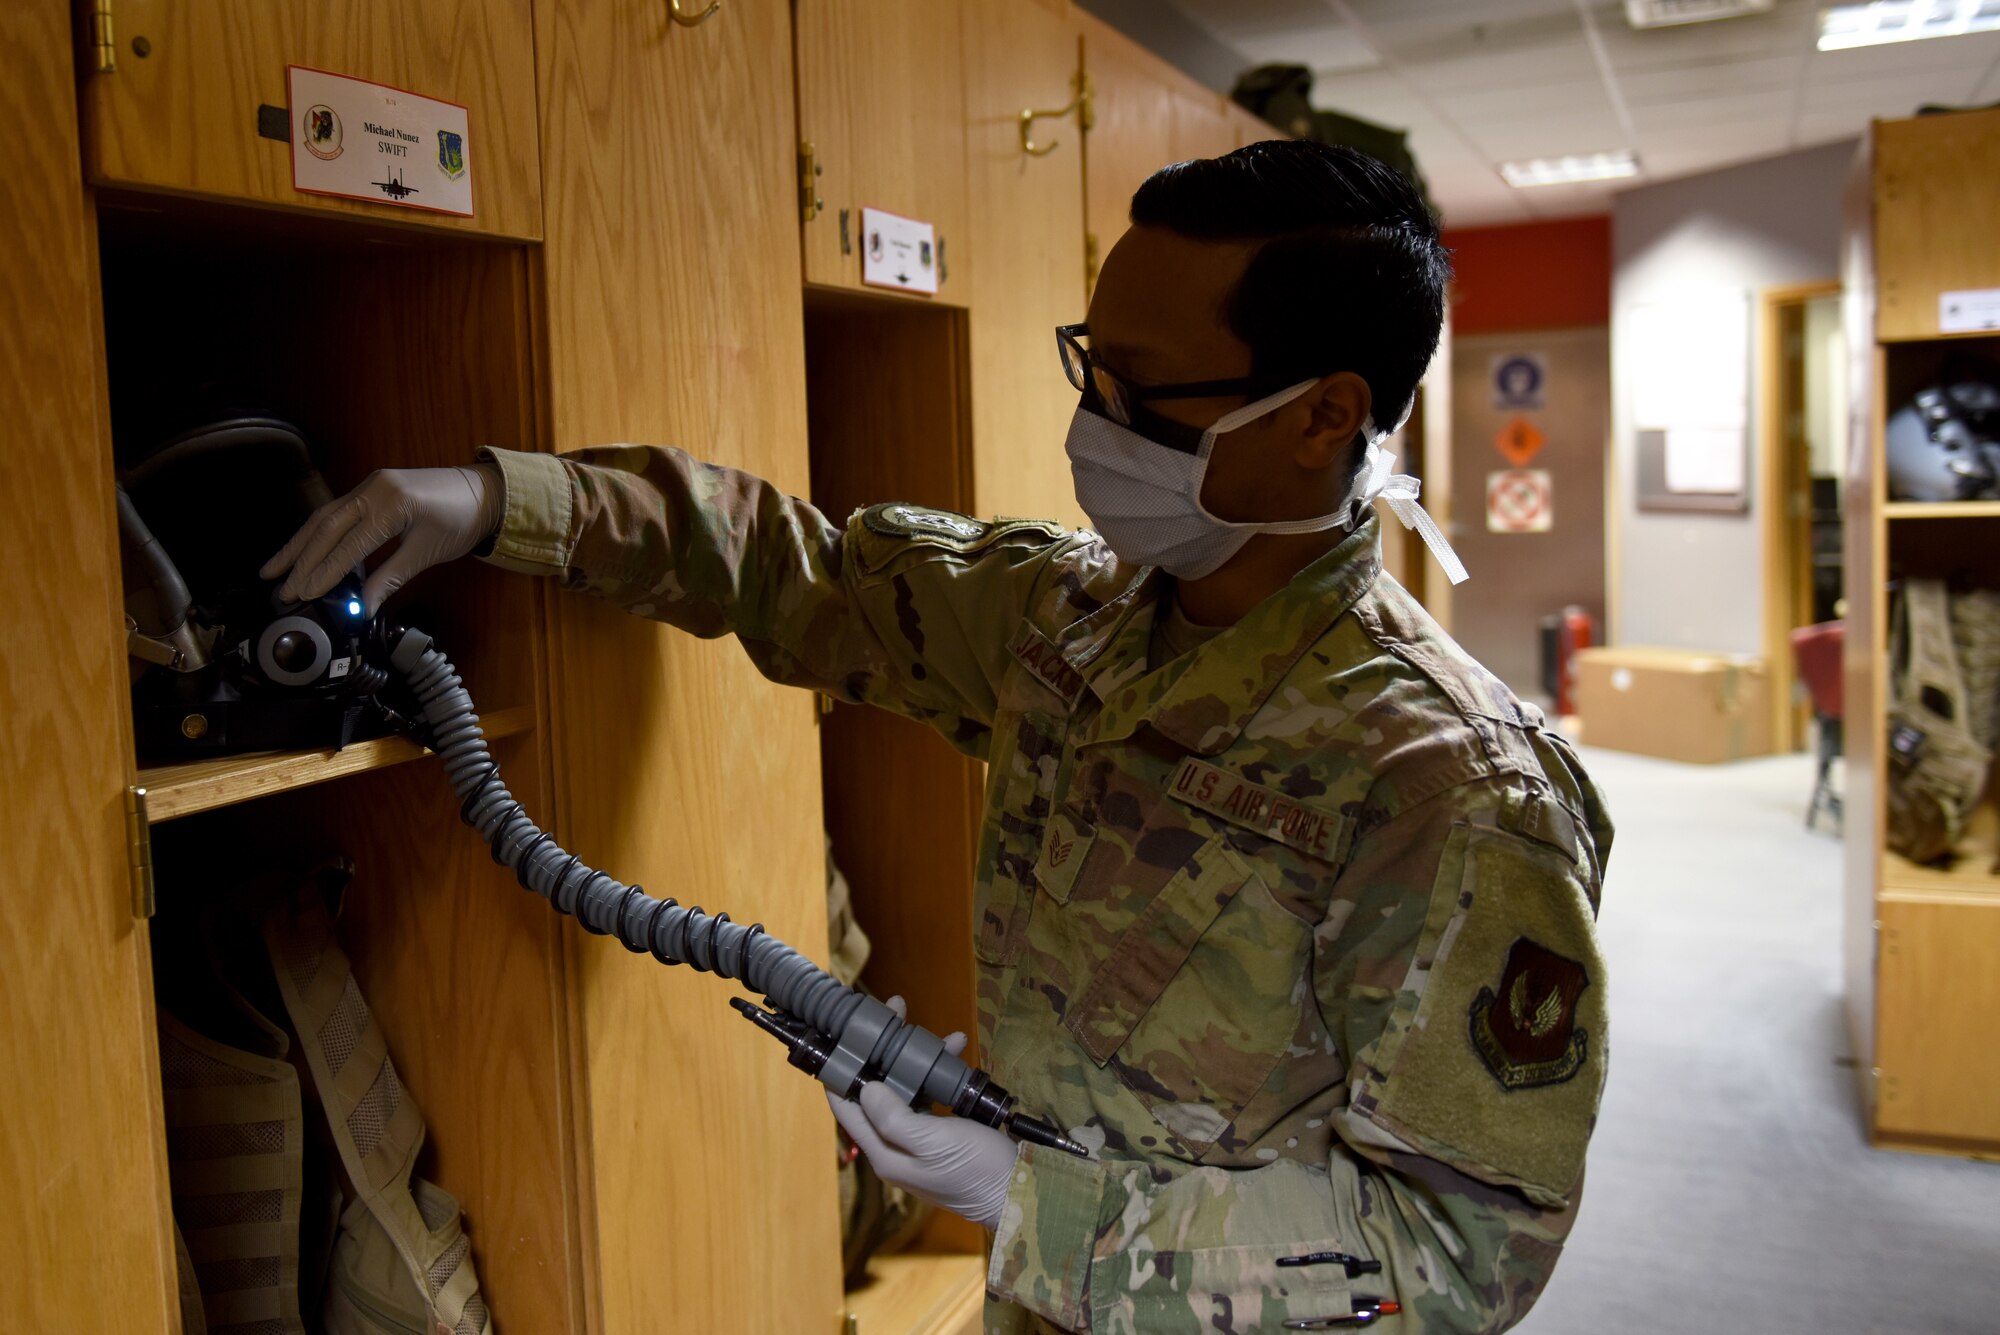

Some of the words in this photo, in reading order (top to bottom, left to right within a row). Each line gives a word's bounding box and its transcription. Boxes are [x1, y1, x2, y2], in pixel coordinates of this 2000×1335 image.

[364, 121, 395, 138] Michael
[396, 129, 420, 144] Nunez
[378, 141, 408, 157] SWIFT
[1176, 763, 1219, 807] U.S.
[1222, 784, 1265, 823] AIR
[1265, 799, 1335, 850] FORCE
